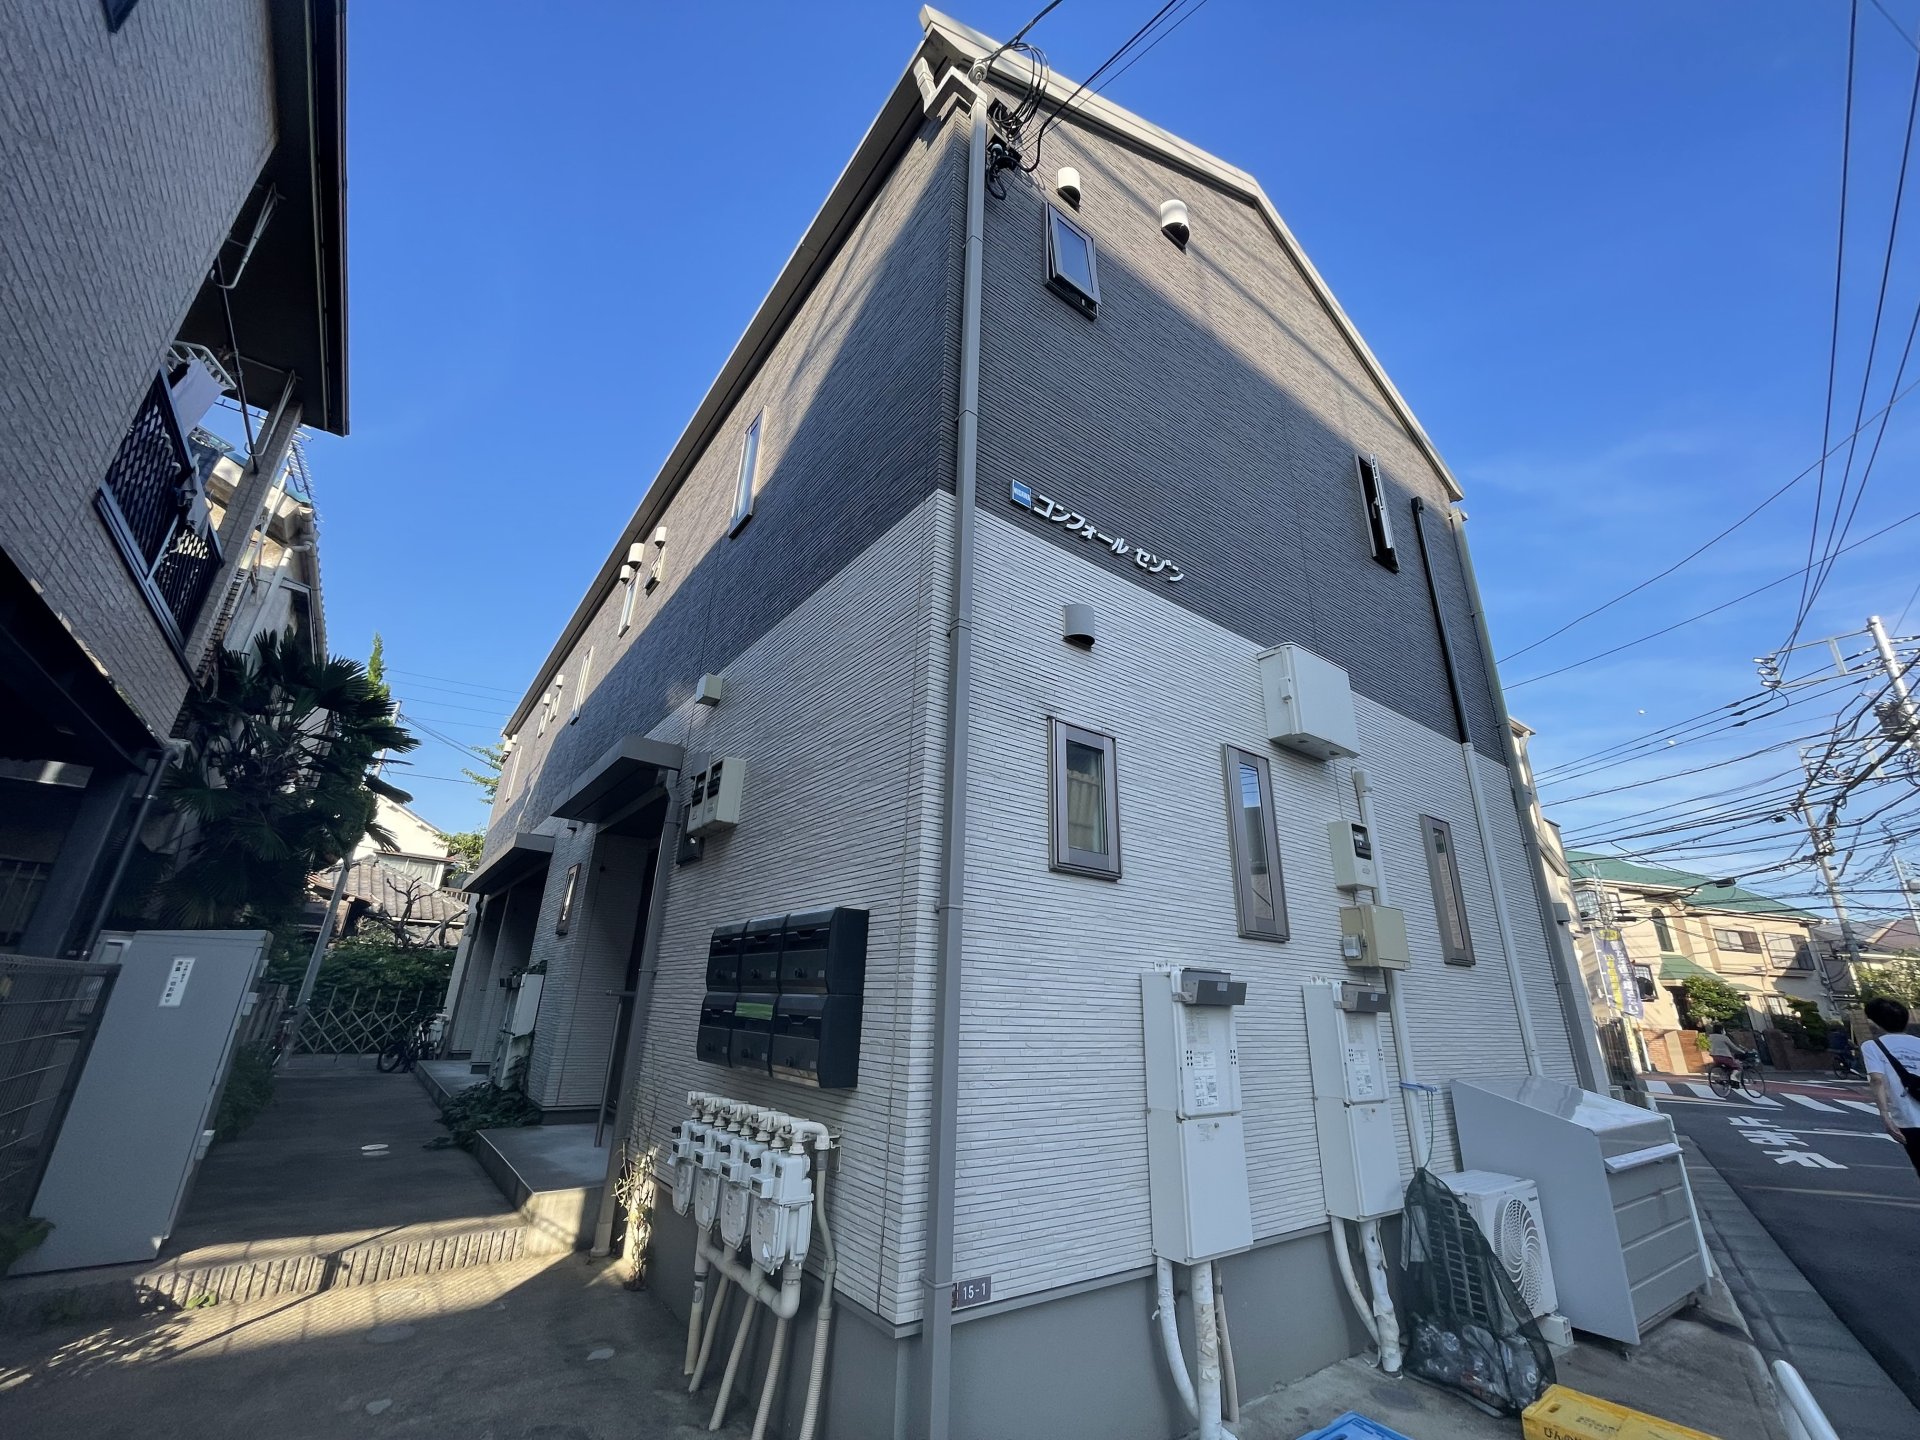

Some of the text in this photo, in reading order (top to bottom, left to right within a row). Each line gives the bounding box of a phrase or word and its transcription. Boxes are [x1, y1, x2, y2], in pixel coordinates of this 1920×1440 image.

[1033, 494, 1185, 582] コンフォール セゾン
[1727, 1115, 1849, 1170] 止まれ
[963, 1282, 986, 1300] 15-1
